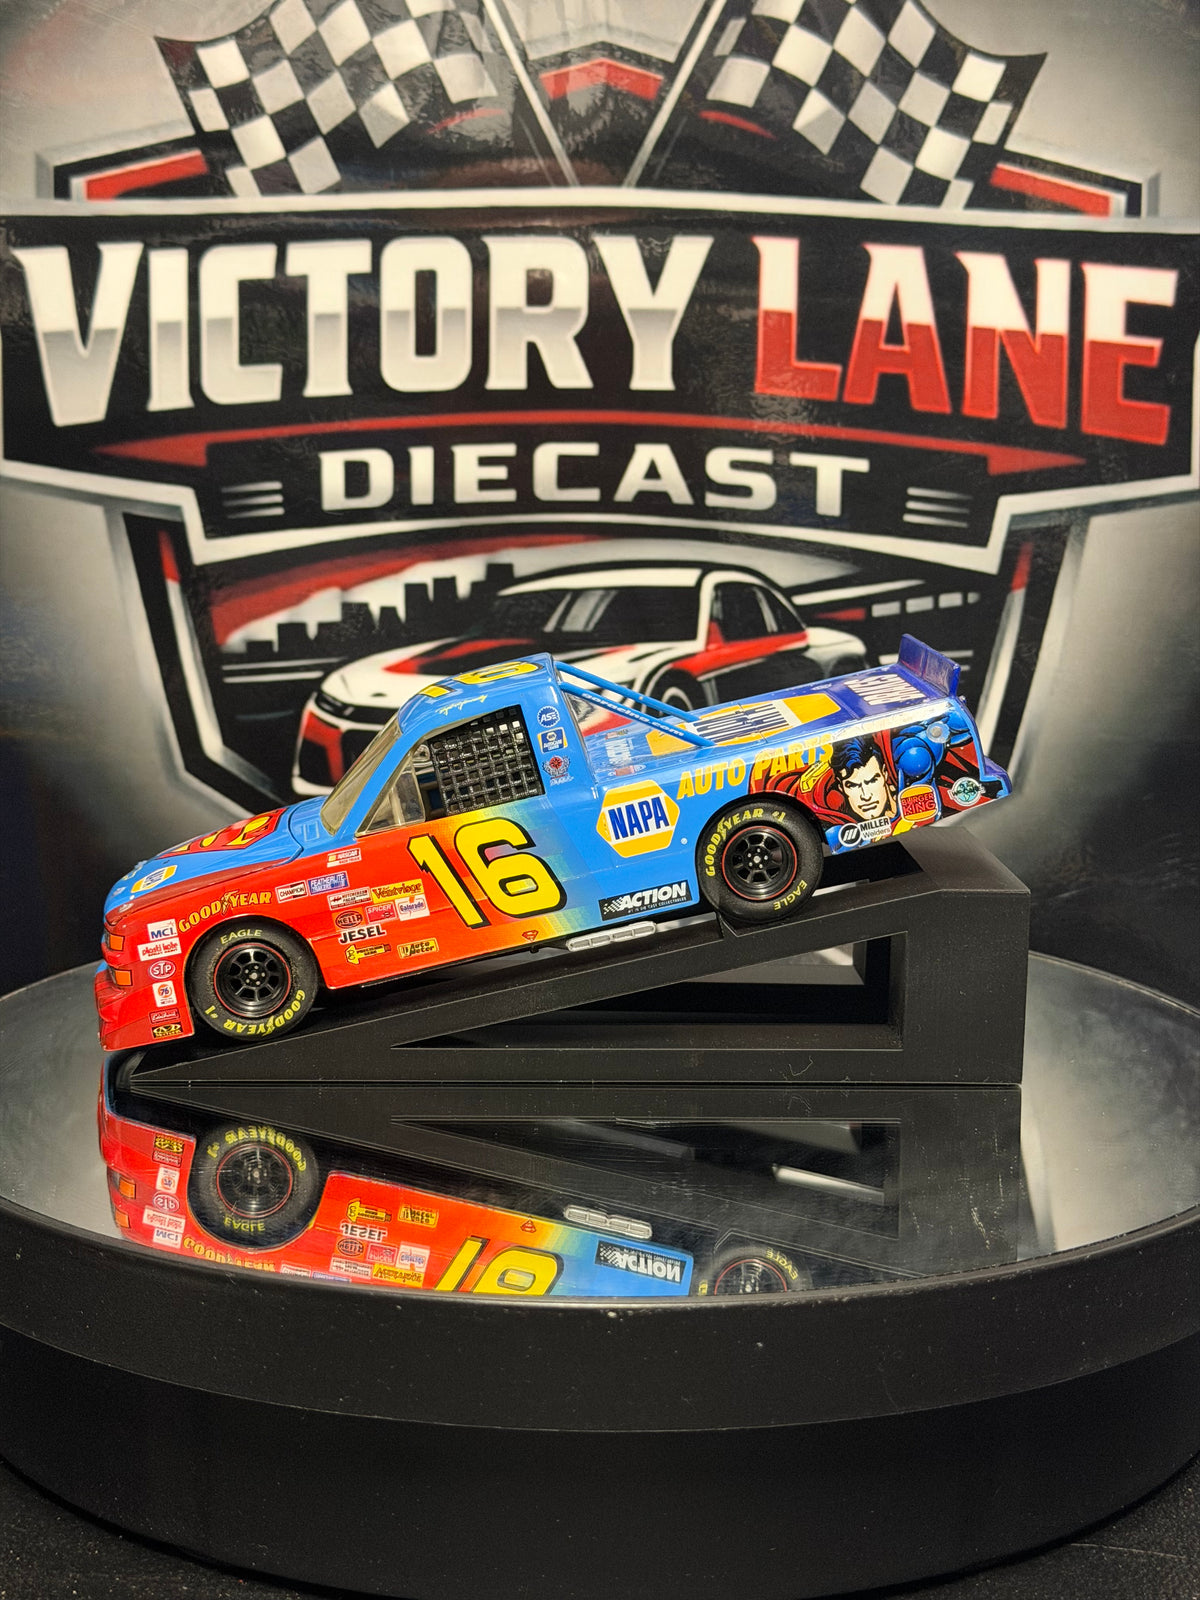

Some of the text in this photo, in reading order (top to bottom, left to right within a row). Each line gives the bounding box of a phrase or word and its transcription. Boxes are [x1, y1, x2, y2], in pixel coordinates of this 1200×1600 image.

[14, 235, 1178, 446] VICTORY LANE
[319, 442, 870, 518] DIECAST
[540, 711, 558, 722] ASE
[676, 733, 834, 800] AUTO PARTS
[901, 792, 935, 805] BURGER
[902, 800, 936, 815] KING
[607, 796, 670, 840] NAPA
[860, 819, 890, 832] MILLER
[862, 828, 891, 839] Welders
[704, 808, 786, 877] GOODYEAR #1
[406, 816, 568, 930] 16
[279, 887, 305, 898] CHAMPION
[617, 881, 687, 911] ACTION
[773, 879, 808, 911] EAGLE
[178, 890, 272, 933] GOODYEAR
[367, 903, 392, 914] SPICER
[150, 927, 174, 940] MCI
[220, 929, 263, 944] EAGLE
[339, 925, 386, 944] JESEL
[409, 940, 430, 951] Auto
[152, 964, 172, 977] STP
[159, 987, 170, 996] 76
[204, 989, 306, 1036] GOODYEAR #1
